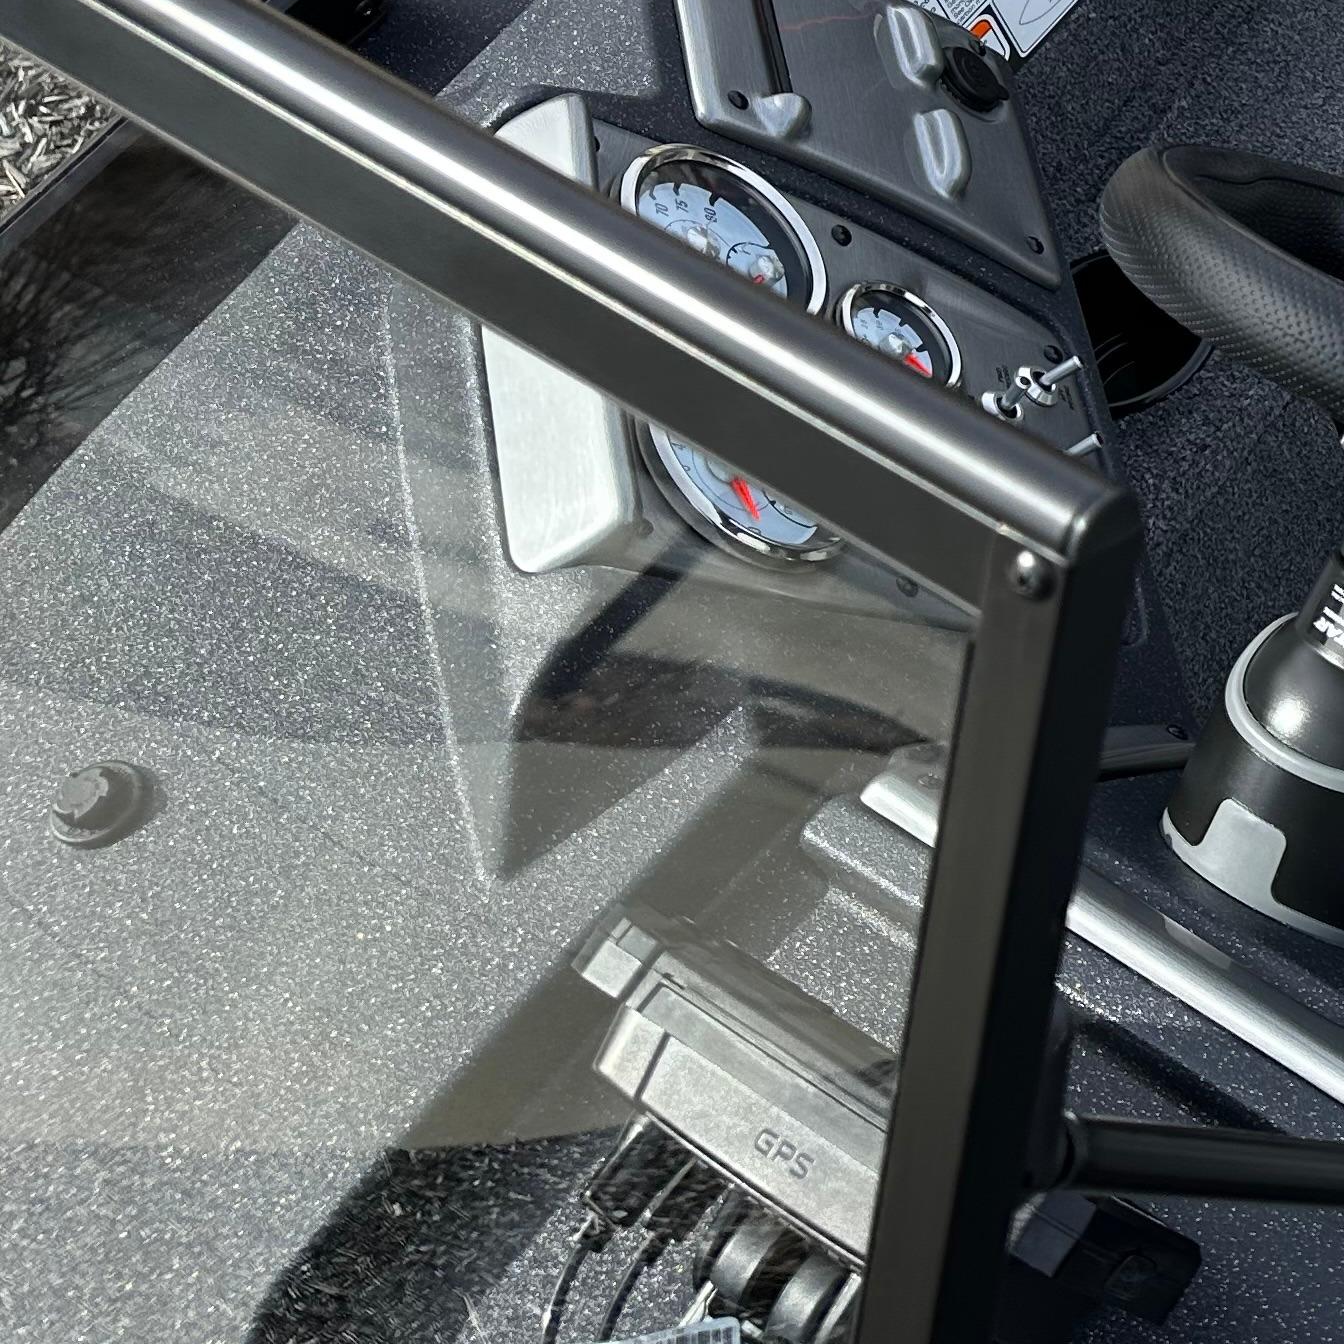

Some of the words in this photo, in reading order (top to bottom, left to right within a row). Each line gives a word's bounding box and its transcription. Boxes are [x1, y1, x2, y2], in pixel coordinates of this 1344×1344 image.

[953, 5, 965, 19] See
[654, 203, 670, 217] 70
[674, 198, 688, 213] 75
[753, 1126, 815, 1181] GPS
